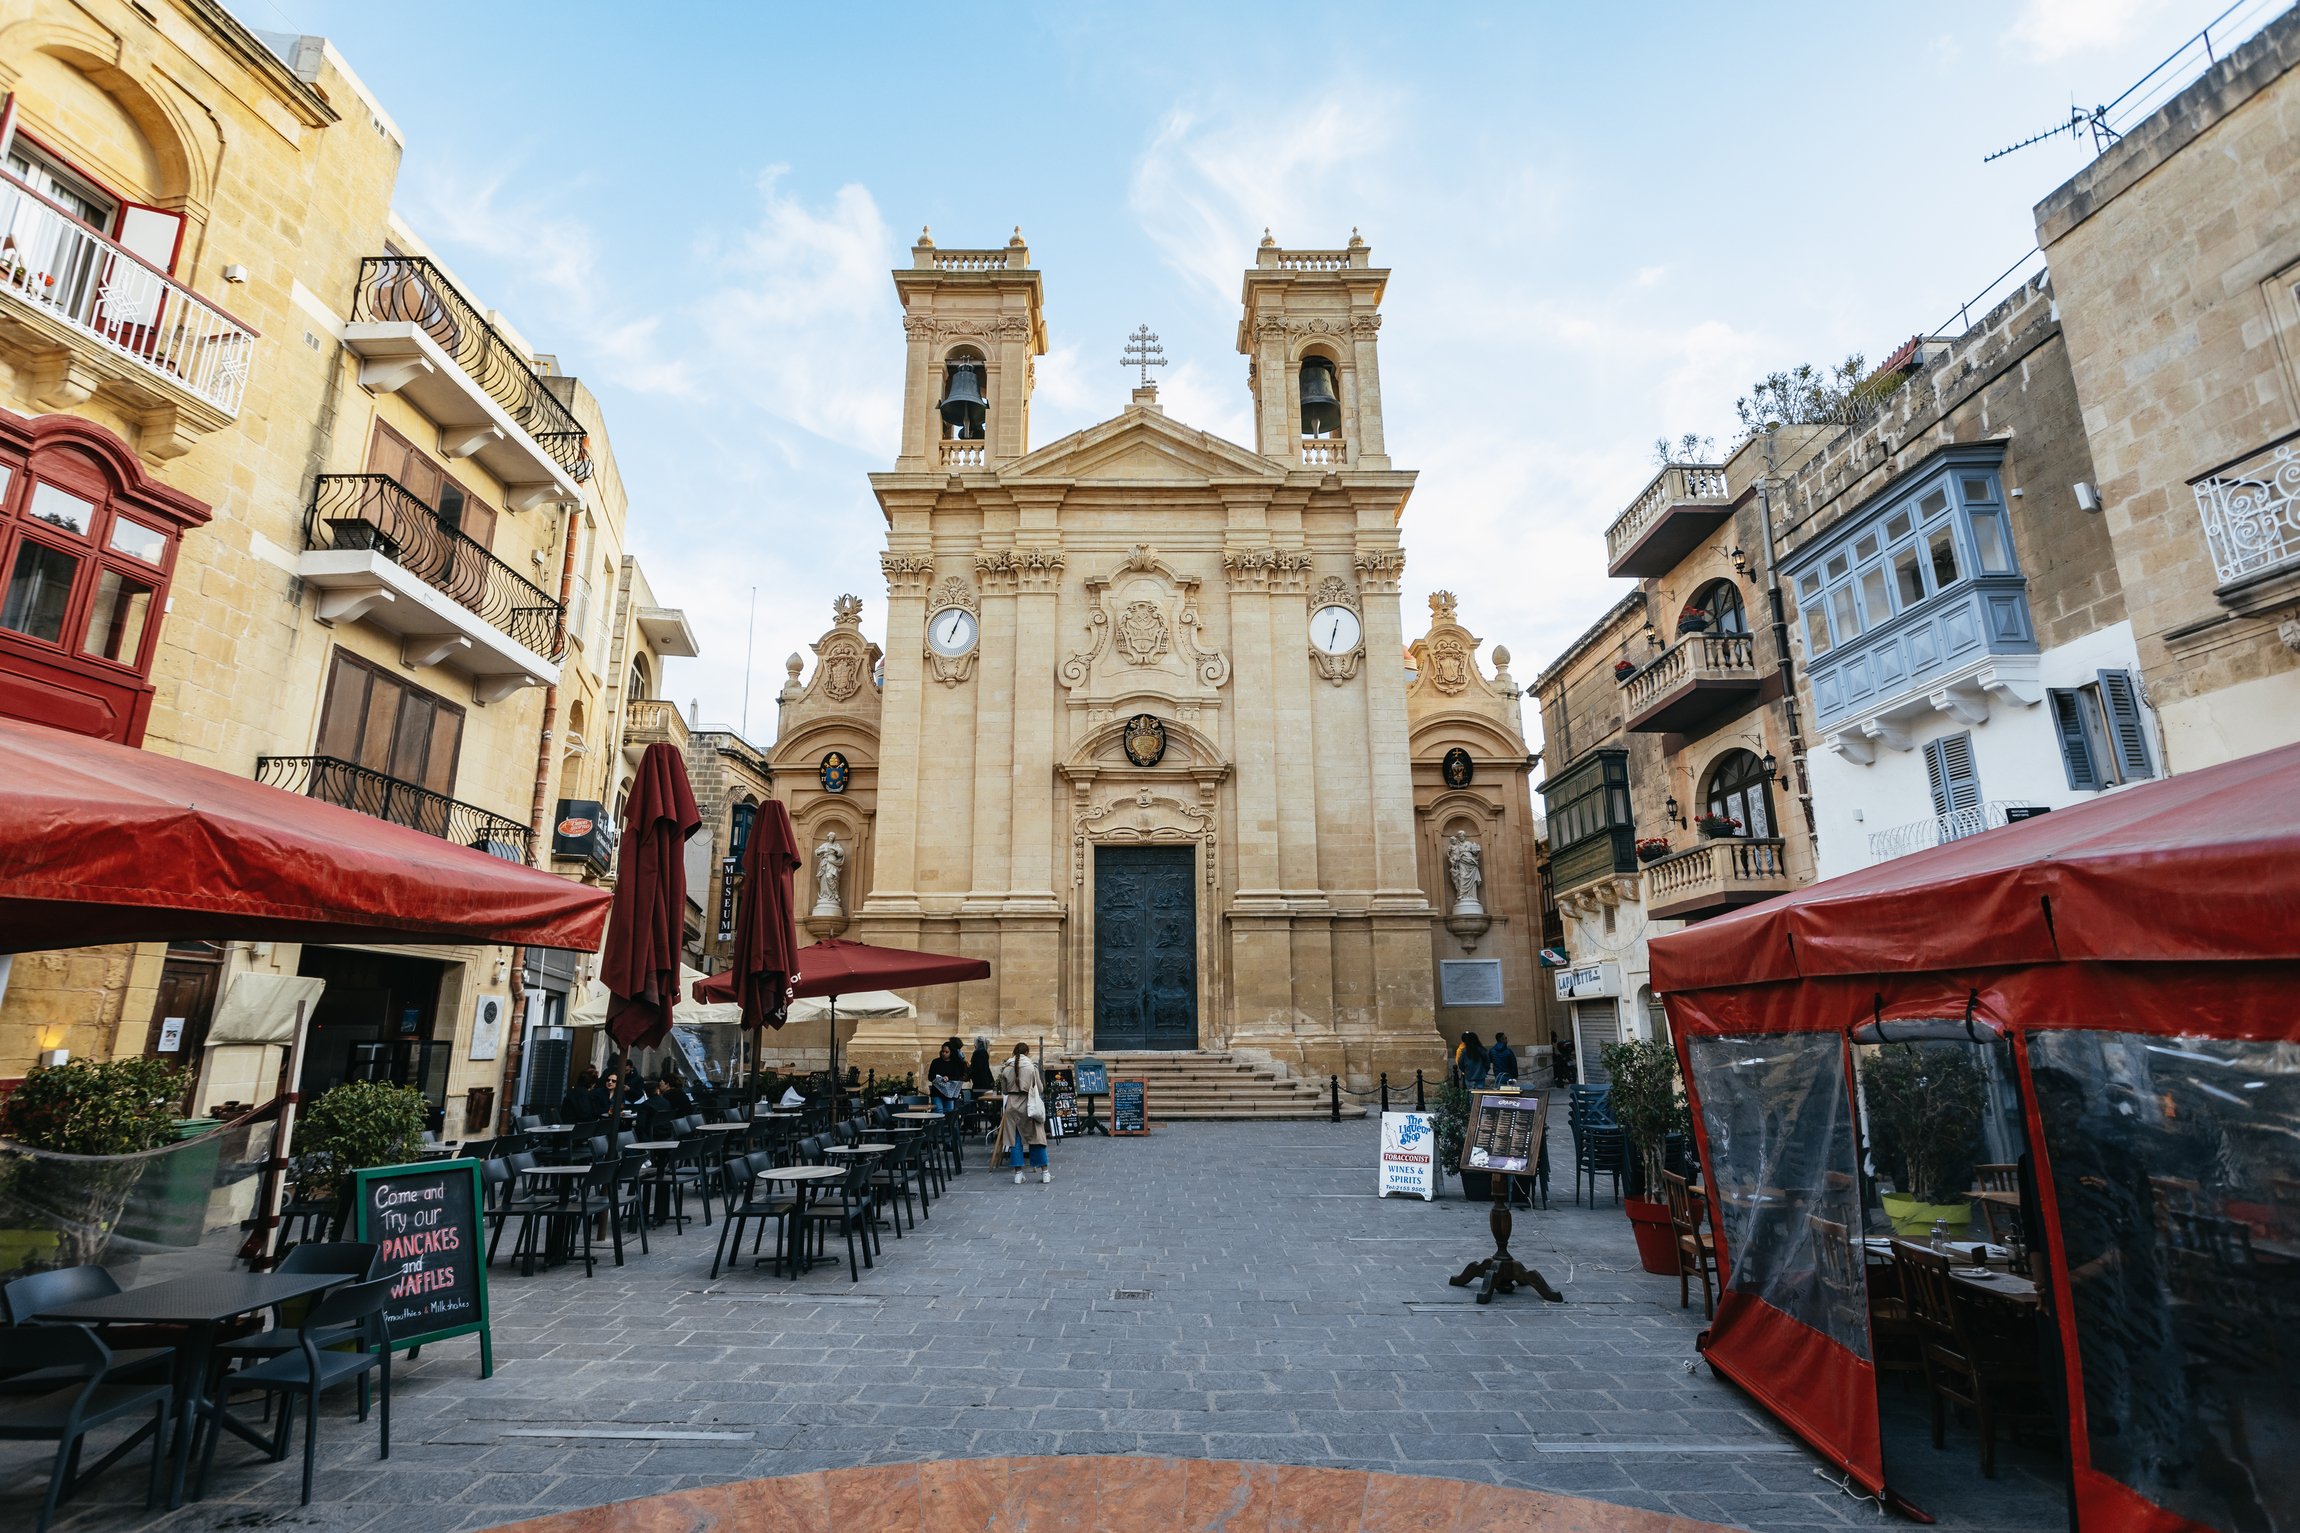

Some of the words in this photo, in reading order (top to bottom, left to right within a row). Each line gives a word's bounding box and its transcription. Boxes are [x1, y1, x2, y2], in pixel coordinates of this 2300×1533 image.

[721, 865, 734, 930] MUSEUM
[1406, 1114, 1423, 1125] The
[1399, 1124, 1431, 1135] Liqueur
[1400, 1133, 1420, 1145] Shop
[1385, 1153, 1429, 1163] TOBACCONIST
[1388, 1165, 1415, 1175] WINES
[1417, 1167, 1424, 1175] &
[1390, 1175, 1422, 1185] SPIRITS
[375, 1184, 418, 1209] Come
[423, 1181, 444, 1200] and
[381, 1209, 407, 1233] Try
[414, 1208, 442, 1227] our
[382, 1226, 460, 1262] PANCAKES
[402, 1254, 424, 1274] and
[390, 1266, 455, 1299] WAFFLES
[430, 1298, 470, 1313] Milkshakes
